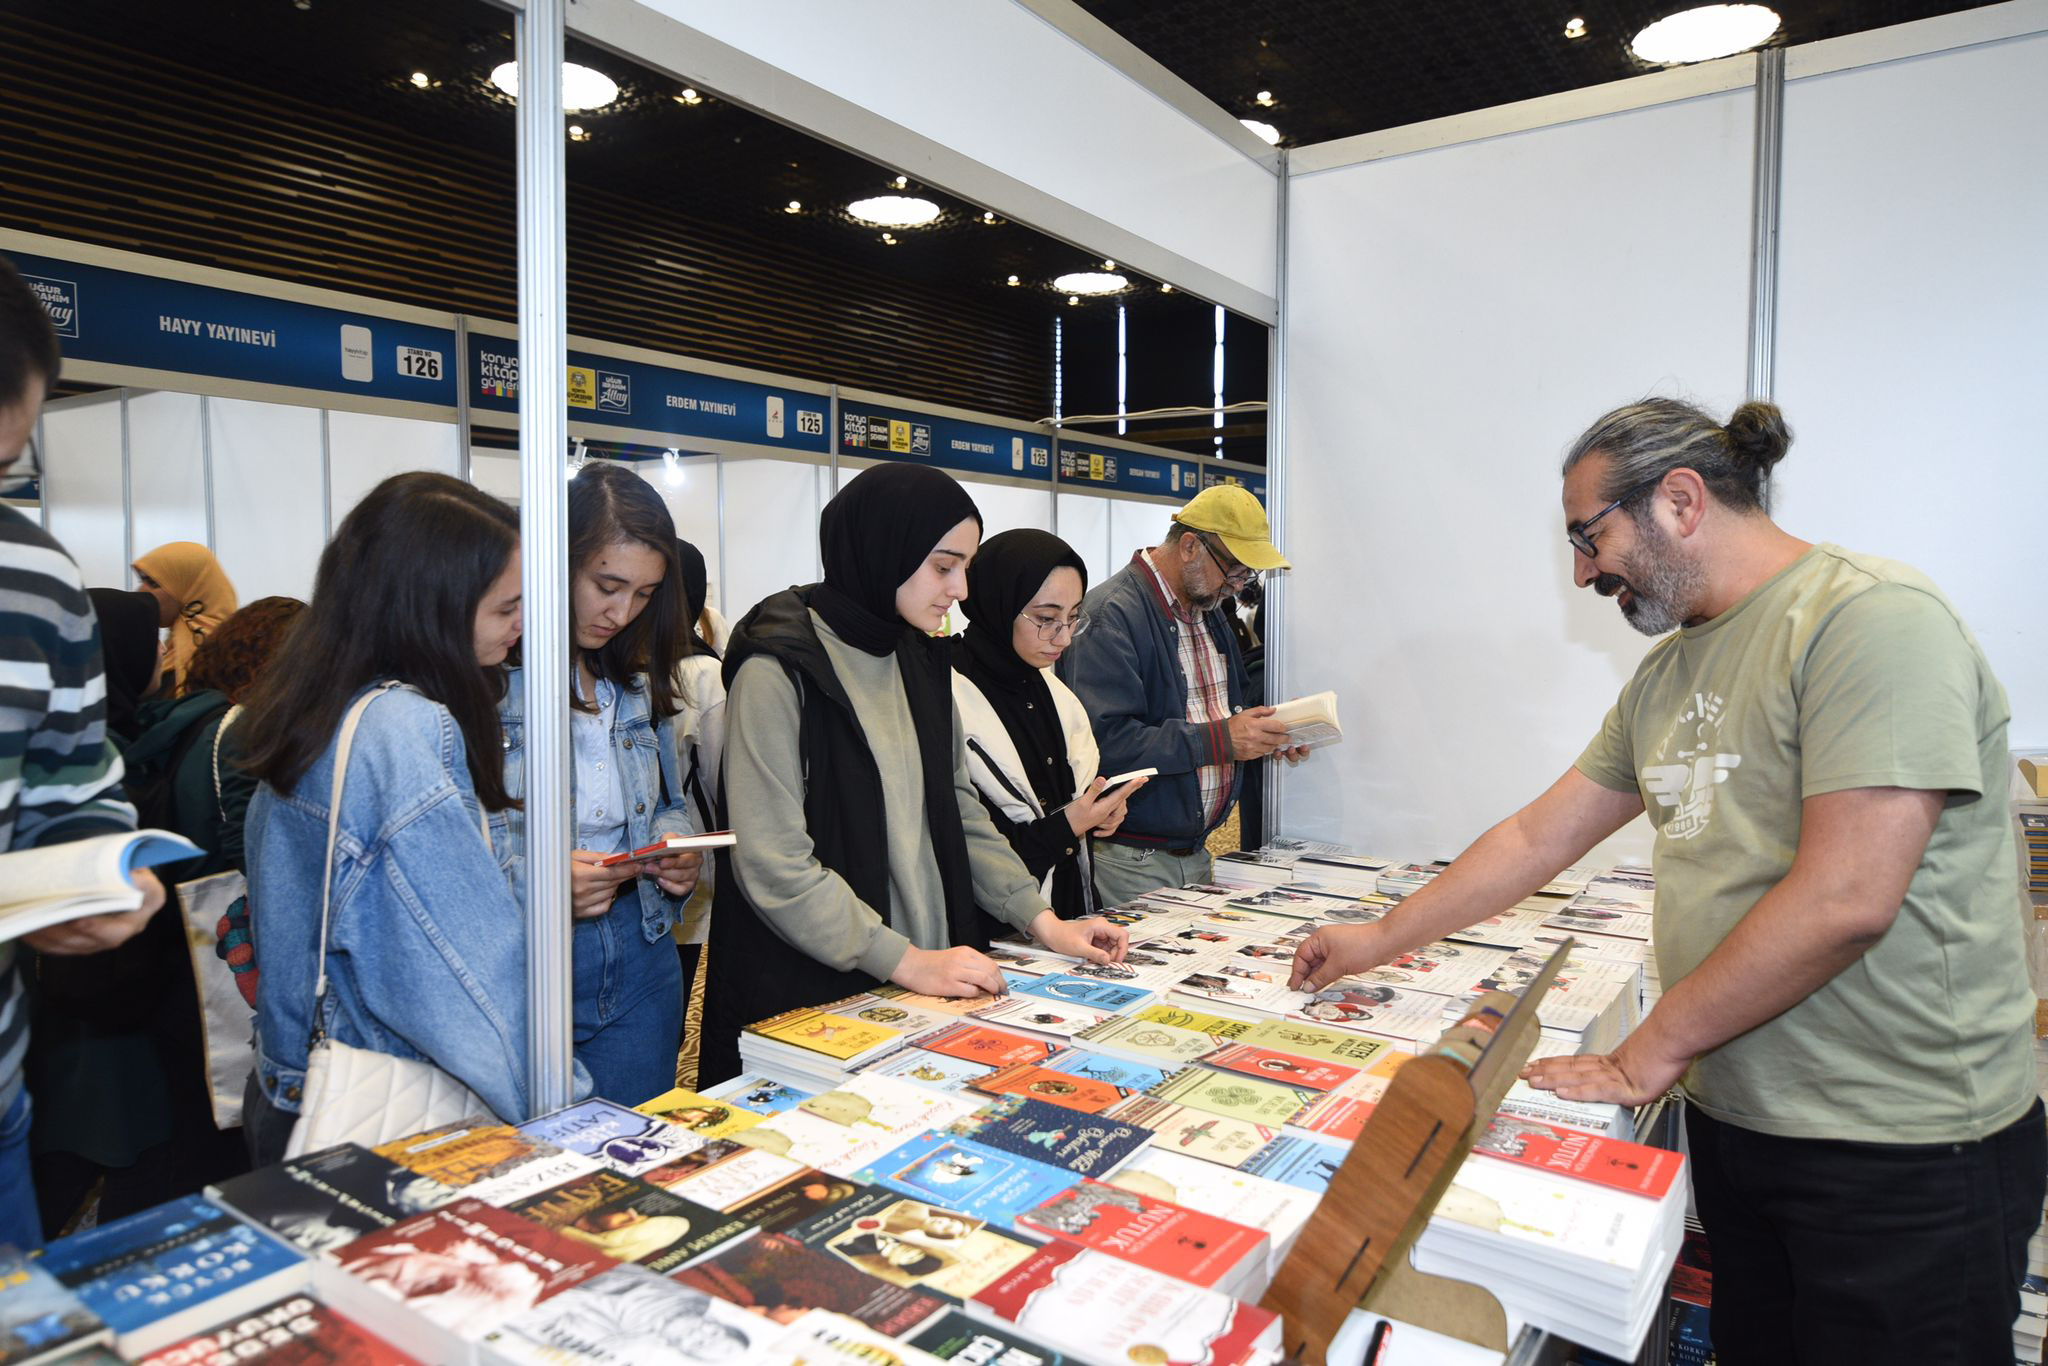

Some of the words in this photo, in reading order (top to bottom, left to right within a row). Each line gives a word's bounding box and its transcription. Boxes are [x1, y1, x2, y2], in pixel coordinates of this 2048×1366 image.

[160, 315, 202, 336] HAYY
[206, 322, 276, 348] YAYINEVİ
[403, 355, 438, 378] 126
[480, 350, 519, 367] konya
[481, 363, 519, 381] kitap
[666, 395, 697, 410] ERDEM
[699, 400, 736, 416] YAYINEVİ
[801, 417, 820, 433] 125
[1033, 452, 1046, 465] 125
[1098, 1128, 1132, 1149] Oscar
[1068, 1147, 1103, 1172] Wilde
[1546, 1133, 1590, 1171] NUTUK
[1102, 1204, 1177, 1250] NUTUK
